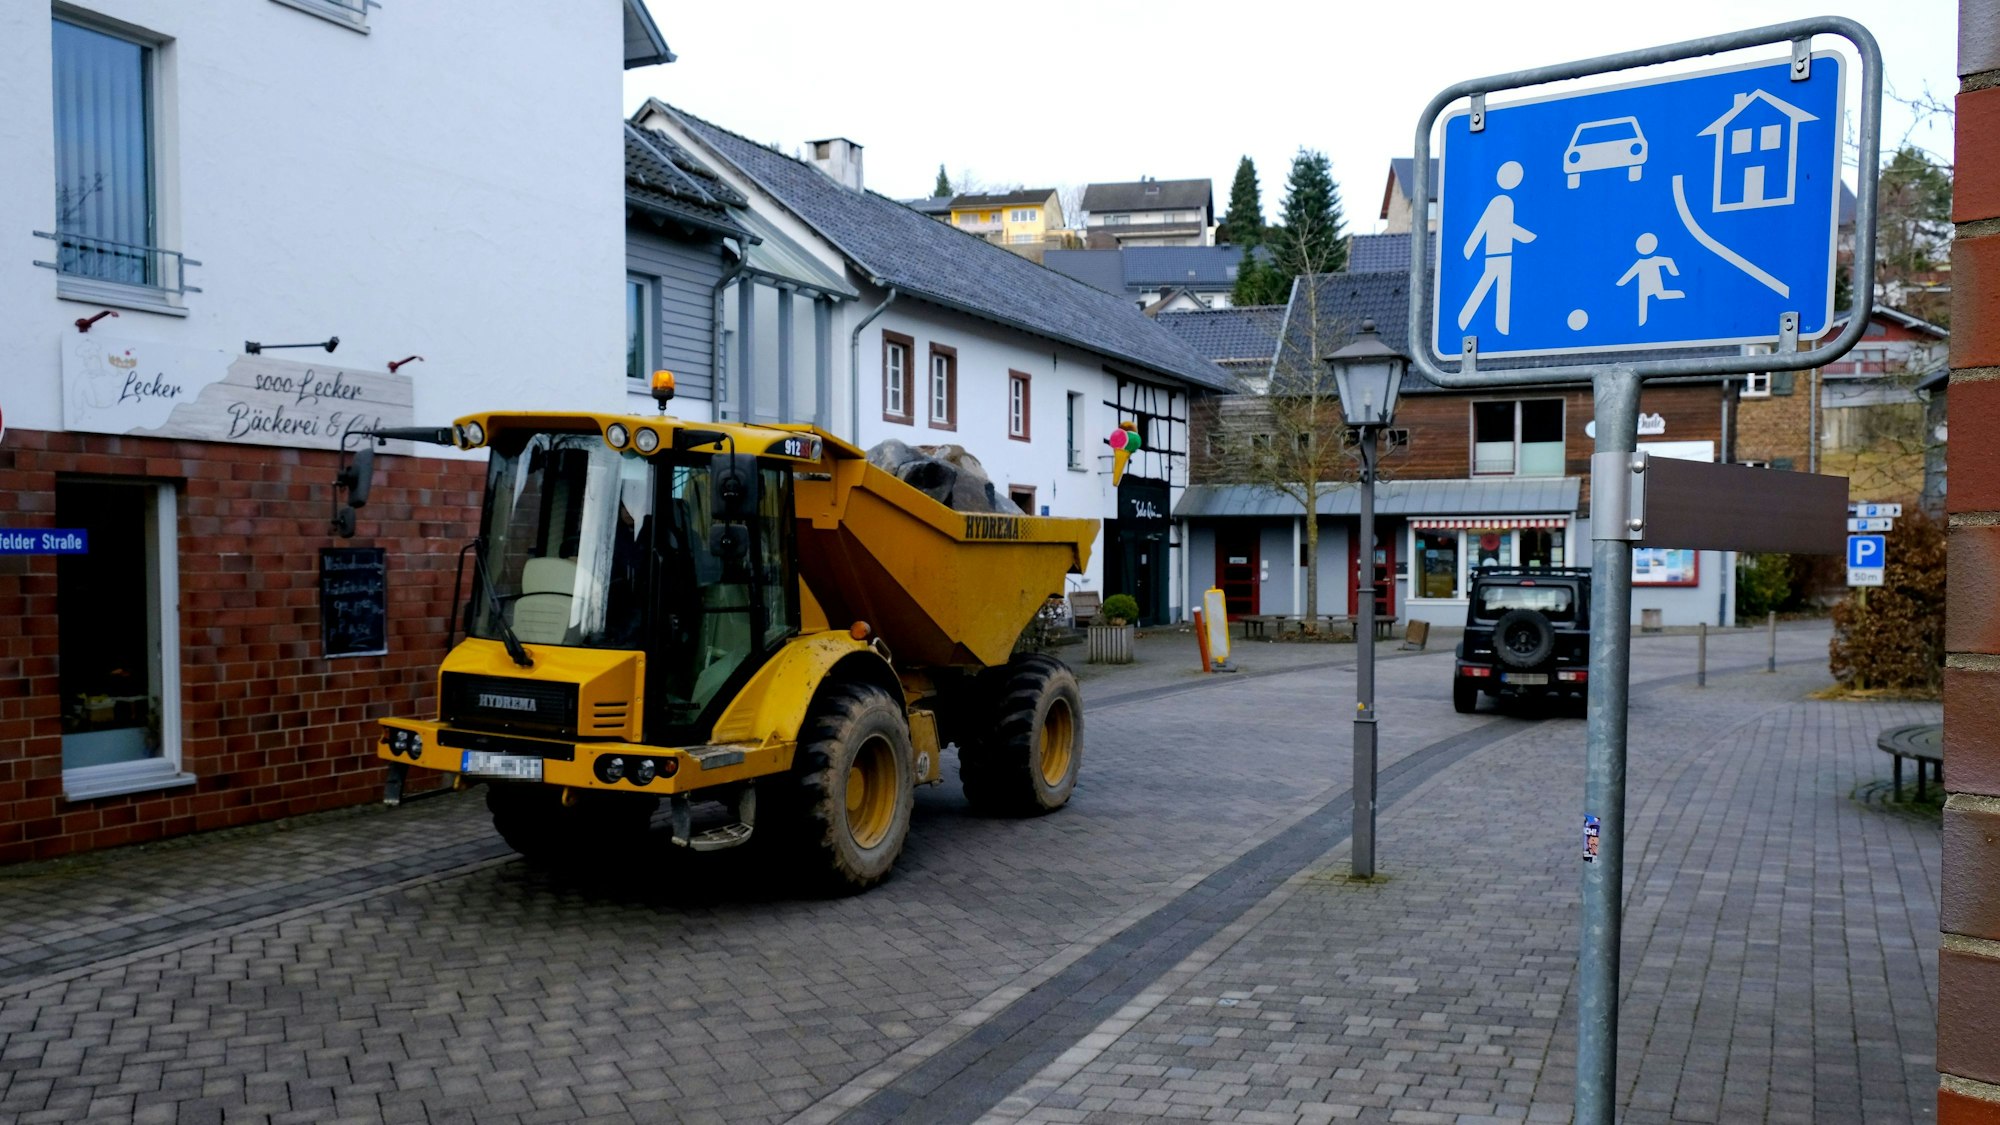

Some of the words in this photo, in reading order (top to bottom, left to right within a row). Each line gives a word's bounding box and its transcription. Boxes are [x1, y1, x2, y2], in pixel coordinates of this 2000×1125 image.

[118, 370, 183, 405] Lecker
[255, 373, 293, 393] sooo
[296, 369, 363, 405] Lecker
[227, 402, 319, 439] Bäckerei
[325, 411, 342, 437] &
[965, 515, 1019, 539] HYDREMA
[42, 533, 82, 550] Straße
[1856, 540, 1876, 565] P
[479, 694, 537, 711] HYDREMA
